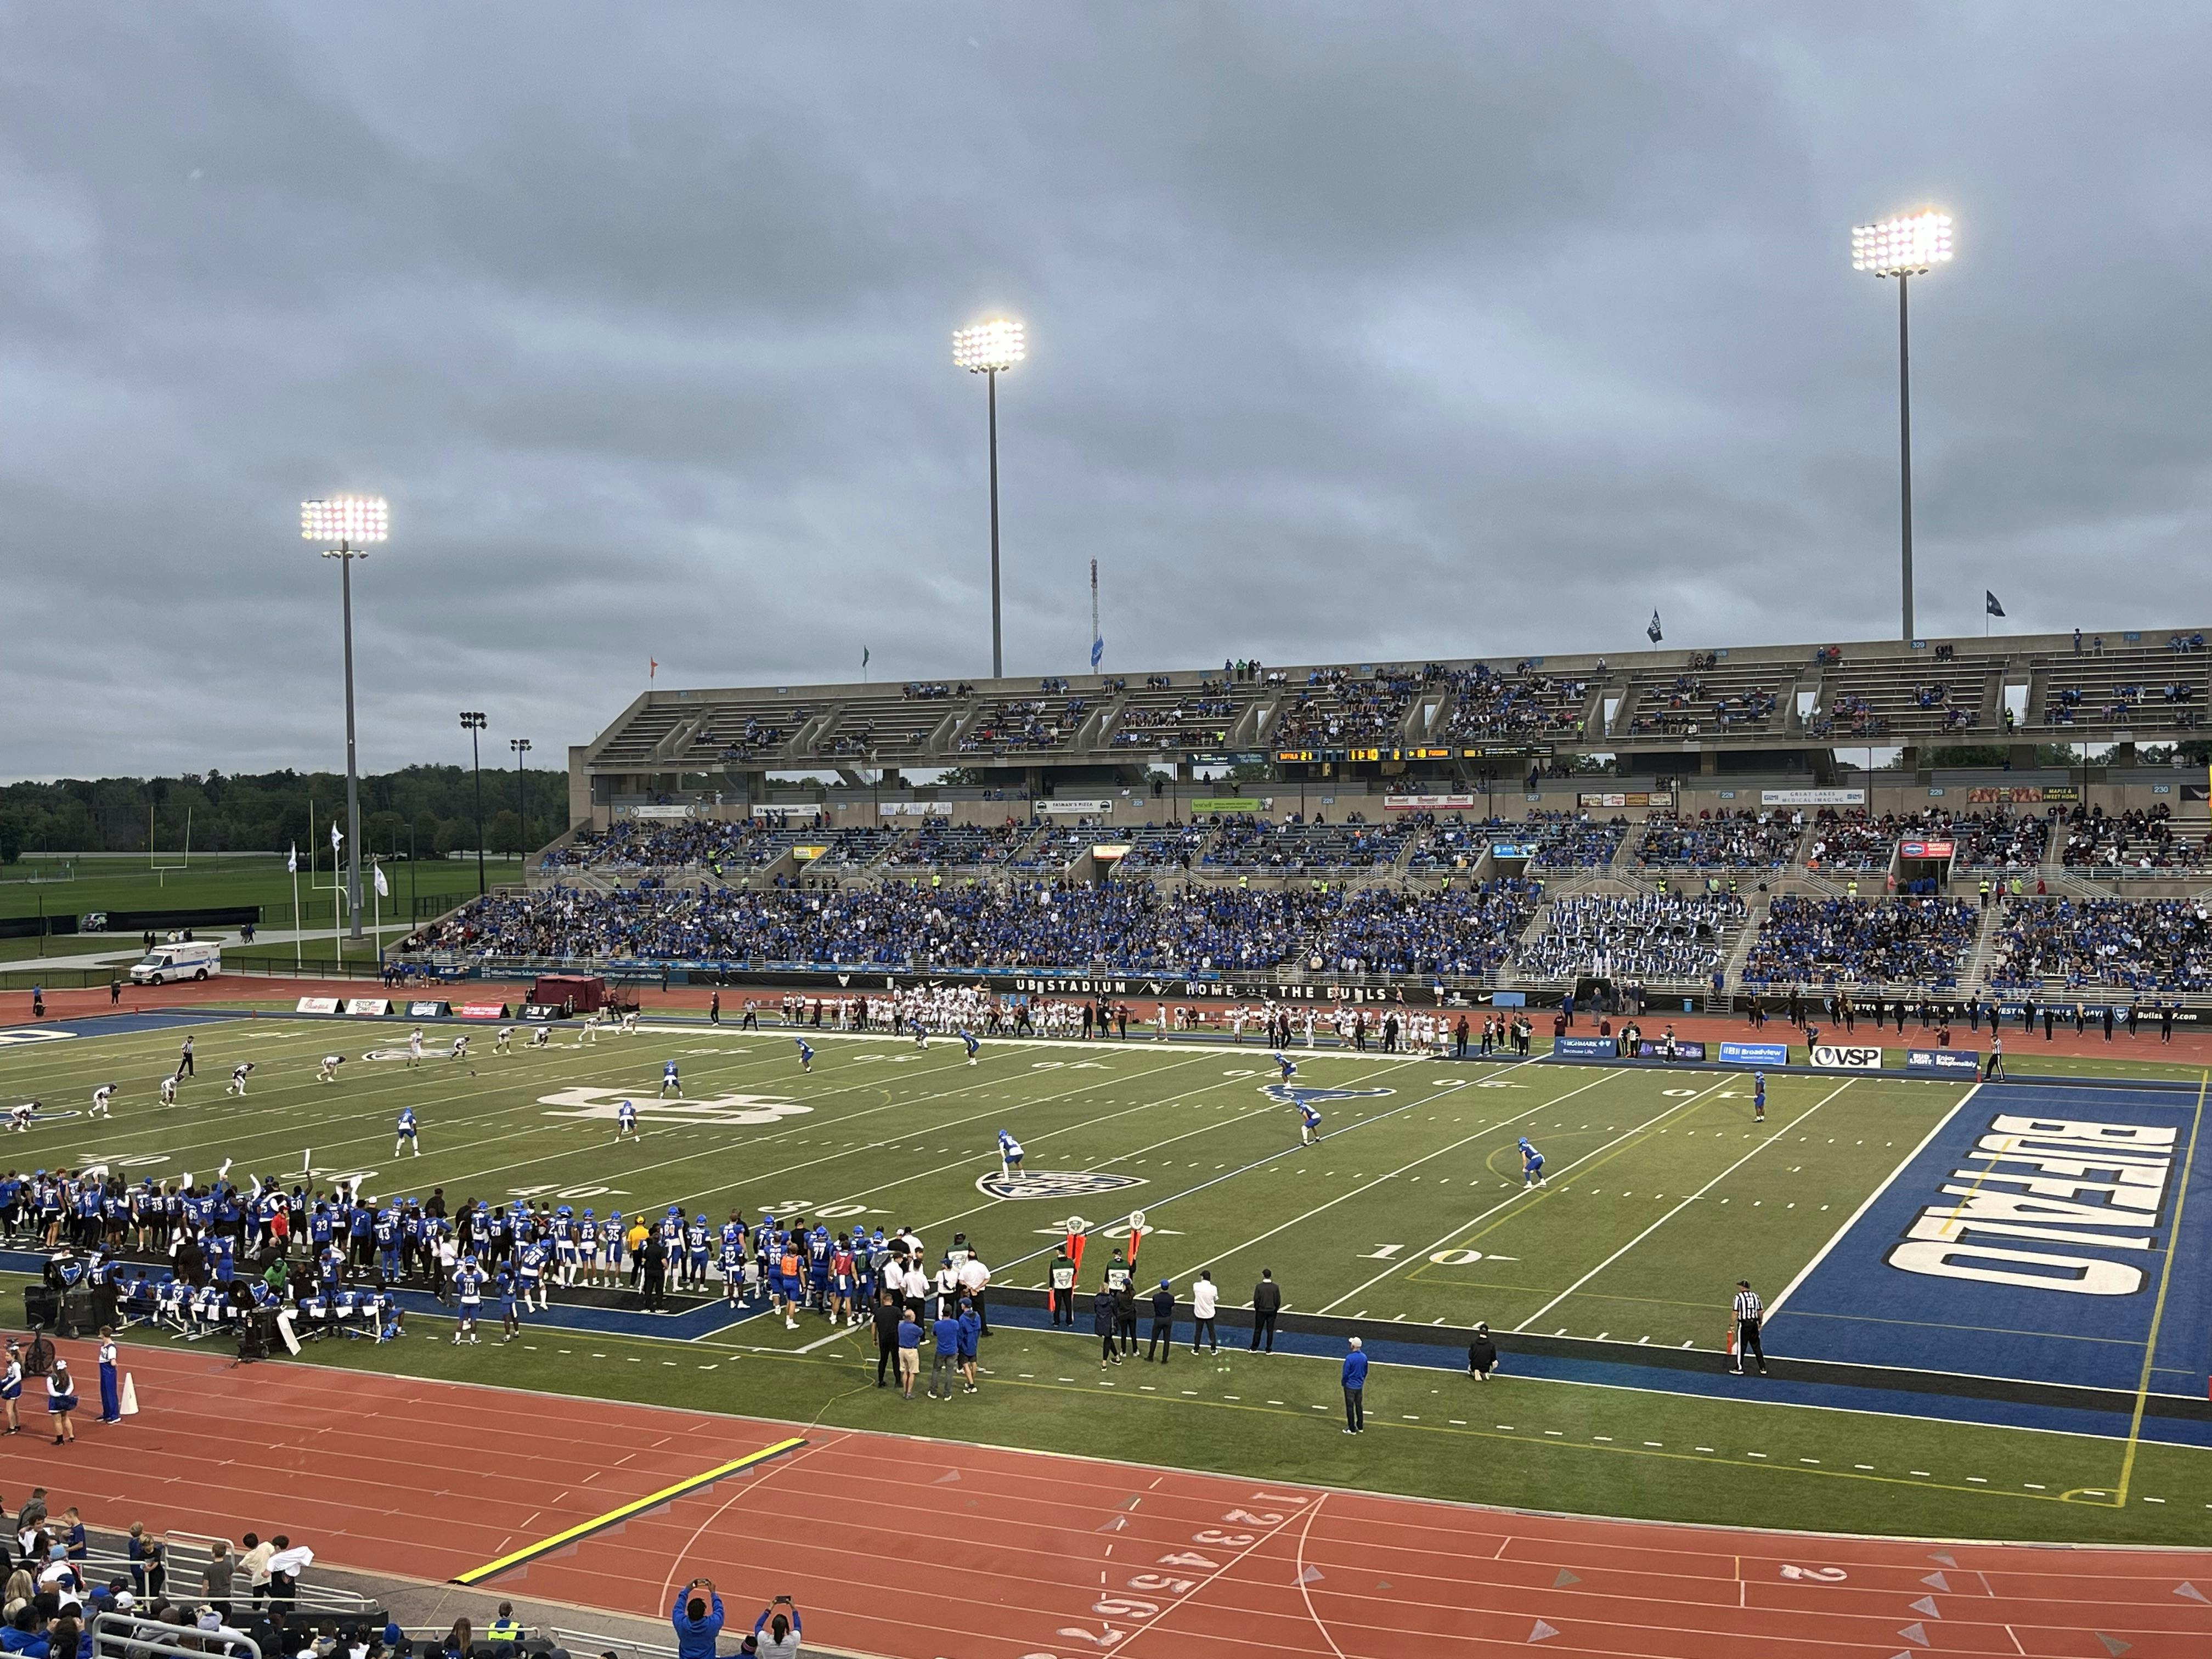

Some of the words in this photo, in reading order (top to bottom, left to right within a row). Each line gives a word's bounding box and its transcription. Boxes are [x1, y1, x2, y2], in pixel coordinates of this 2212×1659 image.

[1301, 751, 1312, 760] 21
[1017, 979, 1036, 991] UB
[1048, 980, 1126, 994] STADIUM
[1186, 984, 1234, 997] HOME
[1279, 985, 1314, 998] THE
[1835, 1047, 1879, 1066] VSP
[505, 1183, 611, 1199] 40
[291, 1199, 303, 1211] 50
[757, 1200, 868, 1218] 30
[1888, 1114, 2177, 1296] BUFFALO
[316, 1220, 328, 1232] 33
[426, 1224, 438, 1237] 97
[490, 1224, 502, 1237] 20
[558, 1224, 567, 1237] 41
[583, 1226, 594, 1239] 83
[1032, 1220, 1155, 1239] 20
[378, 1227, 391, 1240] 43
[607, 1228, 620, 1242] 35
[691, 1233, 703, 1246] 20
[524, 1251, 540, 1266] 36
[725, 1250, 736, 1263] 82
[770, 1252, 781, 1265] 66
[814, 1247, 825, 1260] 77
[1356, 1243, 1483, 1265] 10
[857, 1256, 866, 1268] 10
[464, 1282, 475, 1295] 10
[173, 1290, 184, 1303] 52
[345, 1294, 353, 1305] 3
[1250, 1491, 1310, 1504] 1
[1221, 1508, 1284, 1525] 2
[1192, 1530, 1255, 1547] 3
[1156, 1551, 1220, 1568] 4
[1779, 1564, 1848, 1583] 2
[1127, 1574, 1196, 1594] 5
[1092, 1598, 1159, 1618] 6
[1056, 1627, 1127, 1646] 7
